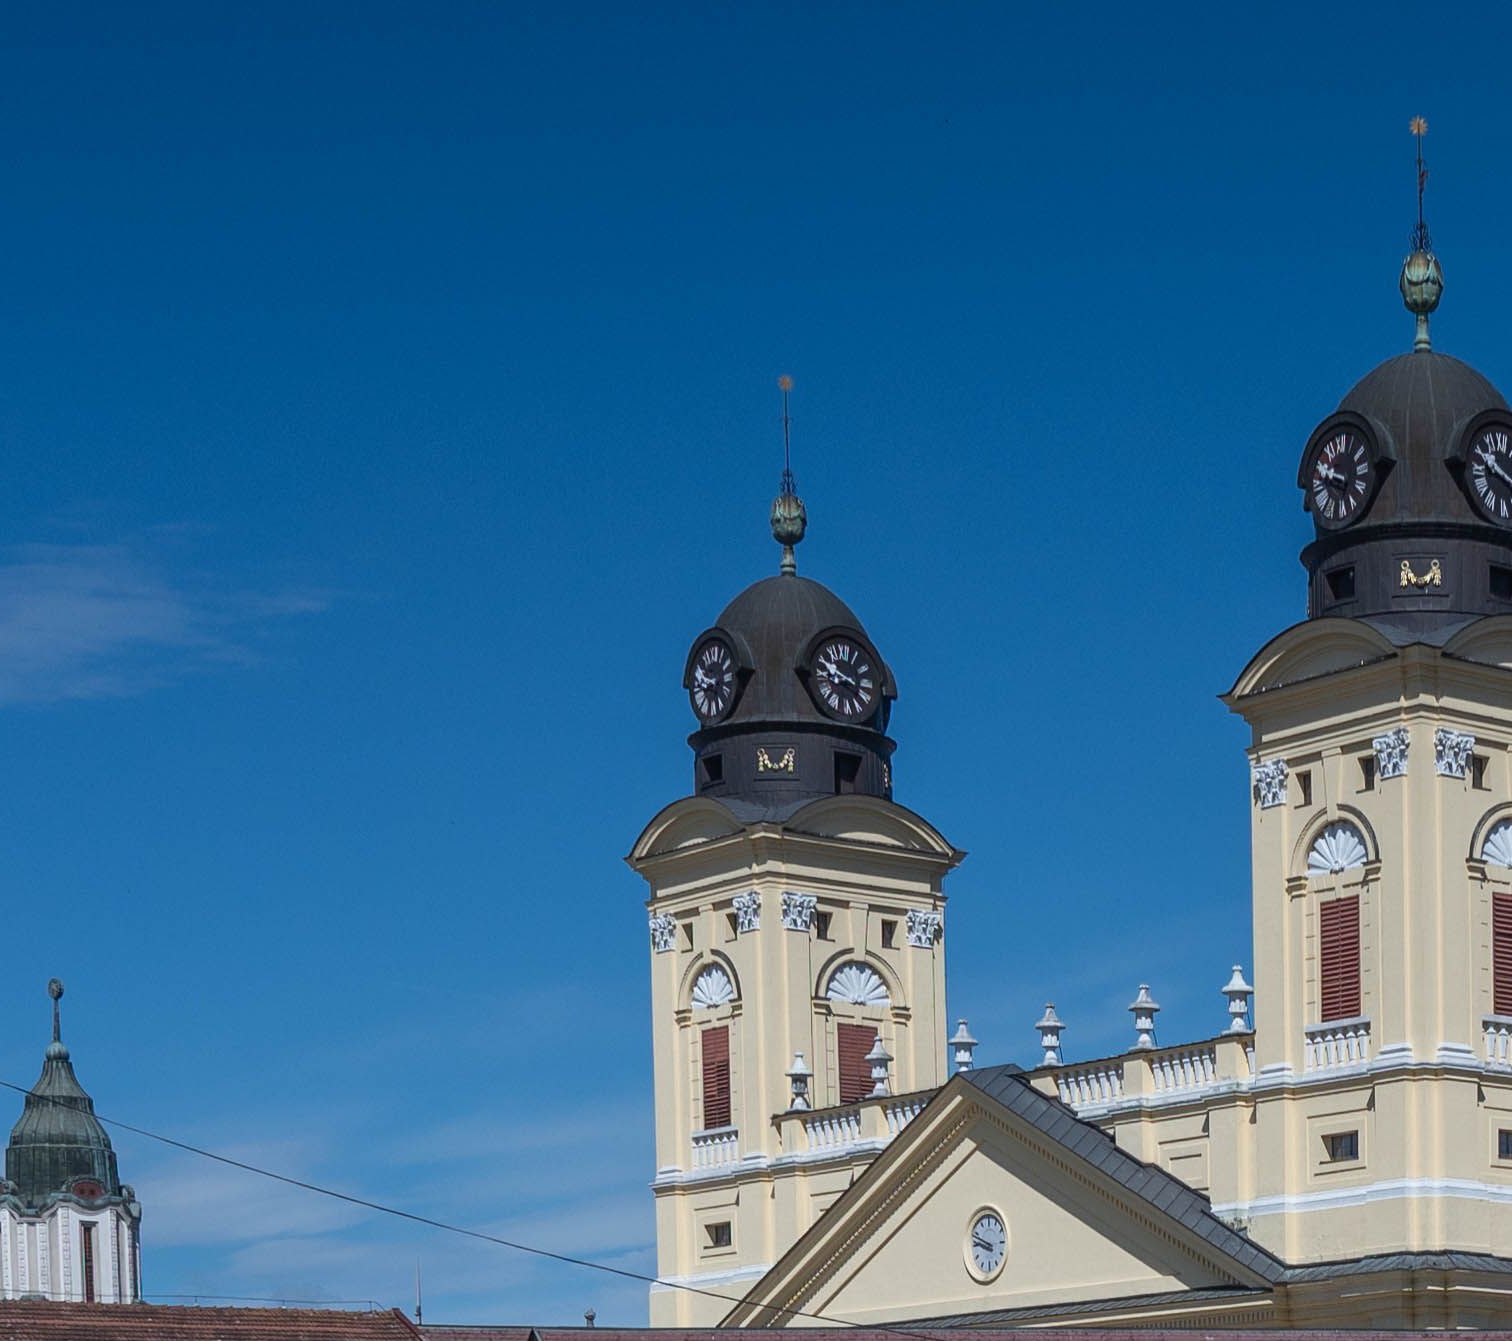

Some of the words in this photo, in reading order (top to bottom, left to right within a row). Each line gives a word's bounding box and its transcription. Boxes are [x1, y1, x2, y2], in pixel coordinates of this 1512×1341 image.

[1483, 432, 1496, 454] XI
[1496, 432, 1508, 454] XII
[1484, 490, 1496, 512] VII
[1501, 498, 1509, 518] VI
